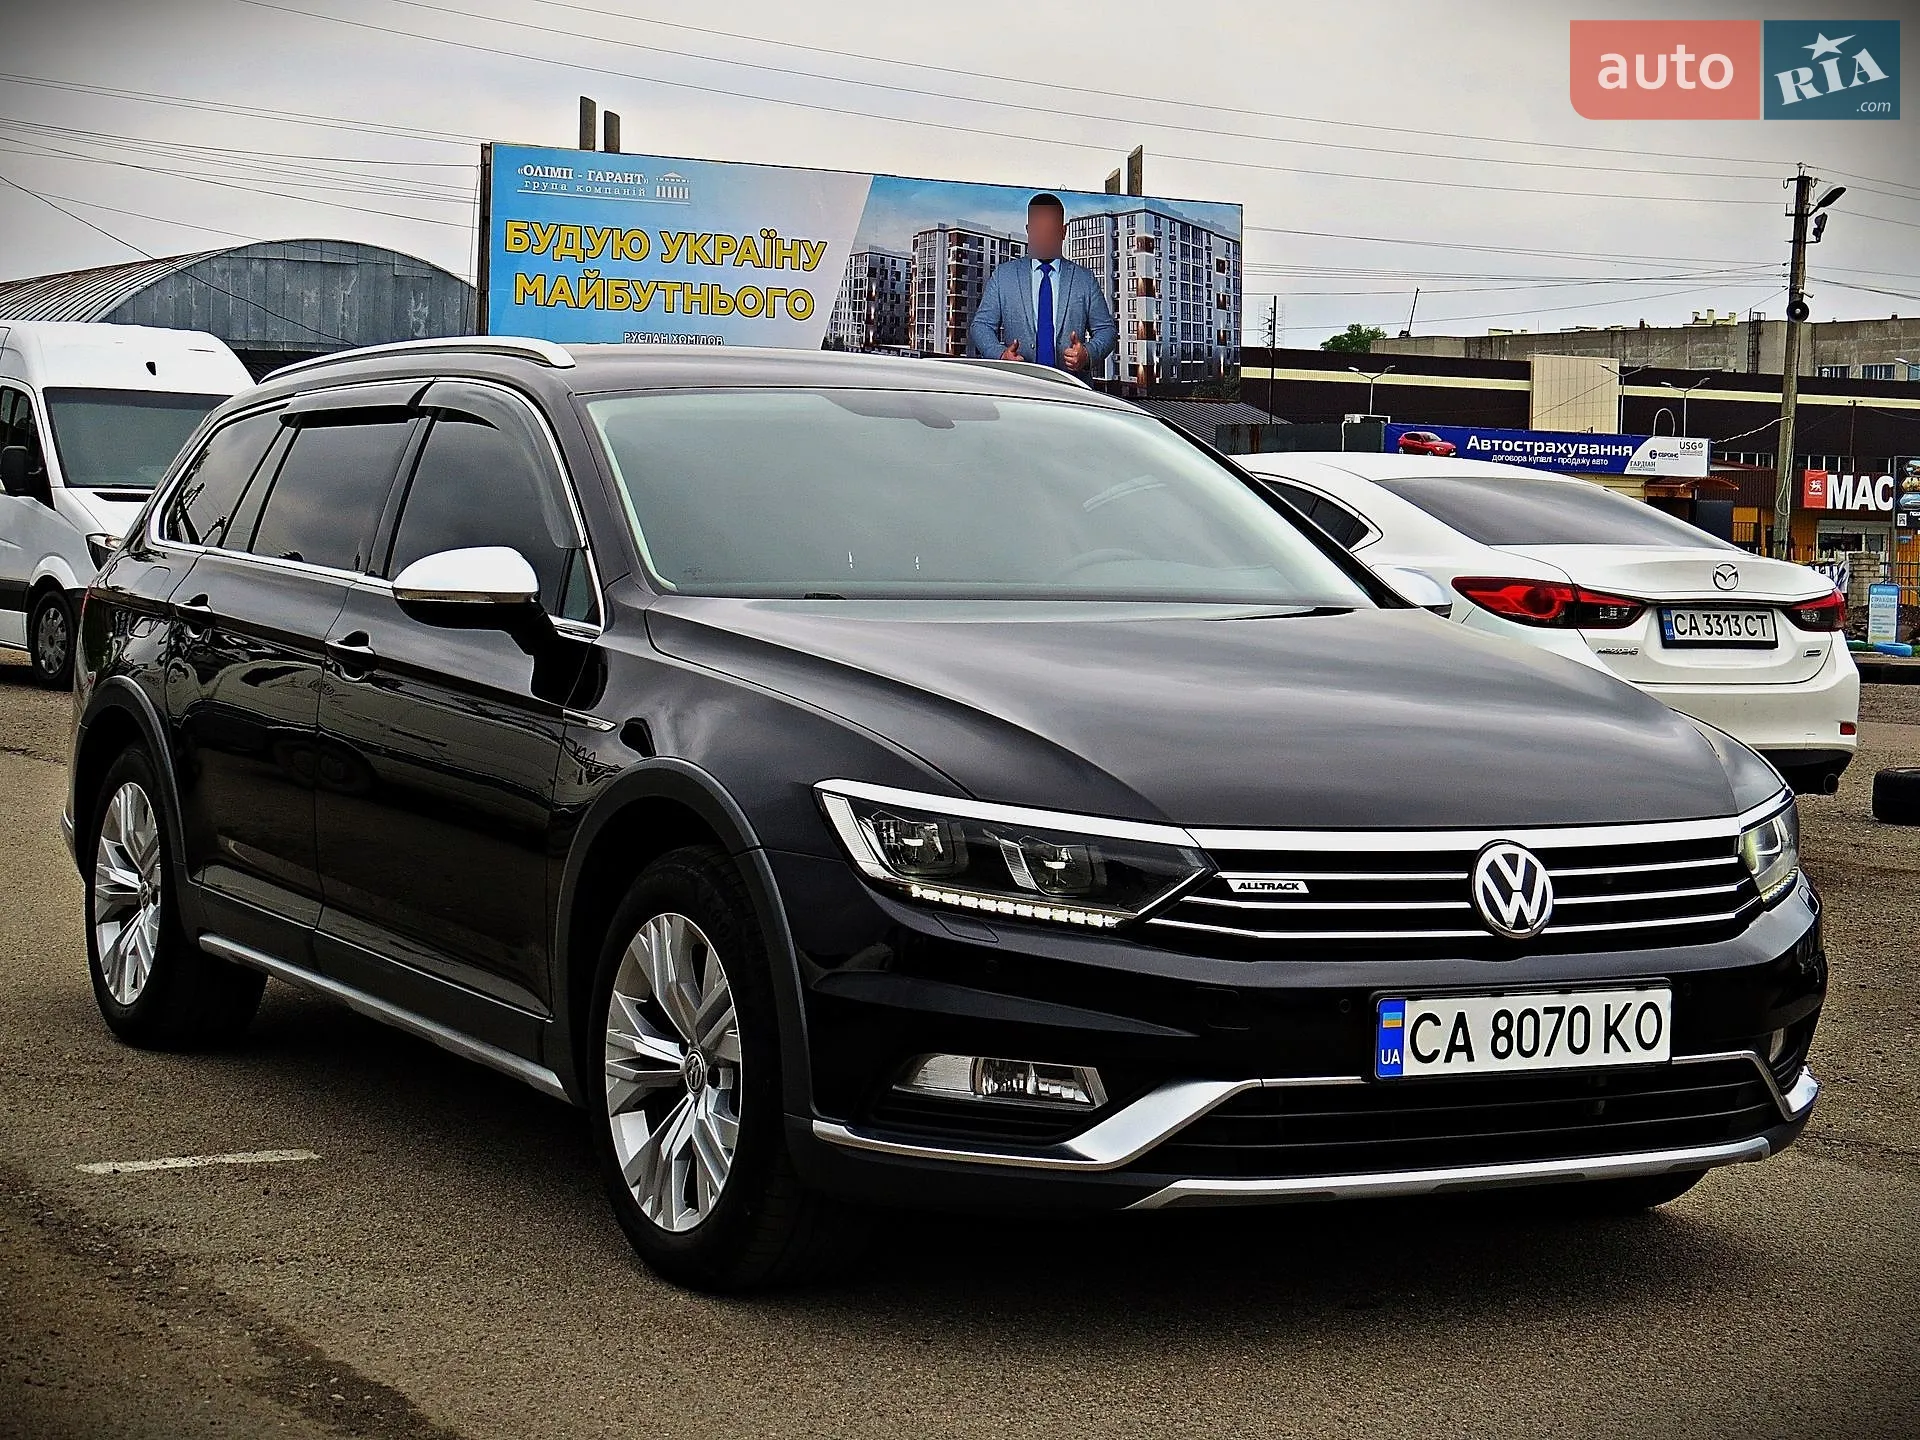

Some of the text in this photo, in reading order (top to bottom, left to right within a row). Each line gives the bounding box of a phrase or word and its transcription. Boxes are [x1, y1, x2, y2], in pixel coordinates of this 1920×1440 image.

[524, 180, 646, 197] група компаній
[505, 220, 827, 272] БУДУЮ УКРАЇНУ
[514, 269, 815, 321] МАЙБУТНЬОГО
[624, 332, 669, 344] РУСЛАН
[1466, 435, 1633, 457] Автострахування
[1491, 454, 1527, 463] договора
[1528, 454, 1553, 464] купівлі
[1558, 457, 1590, 467] продажу
[1591, 458, 1609, 466] авто
[1674, 613, 1768, 637] CA 3313 CT
[1237, 882, 1300, 891] ALLTRACK
[1409, 1001, 1664, 1064] CA 8070 KO
[1381, 1049, 1401, 1065] UA
